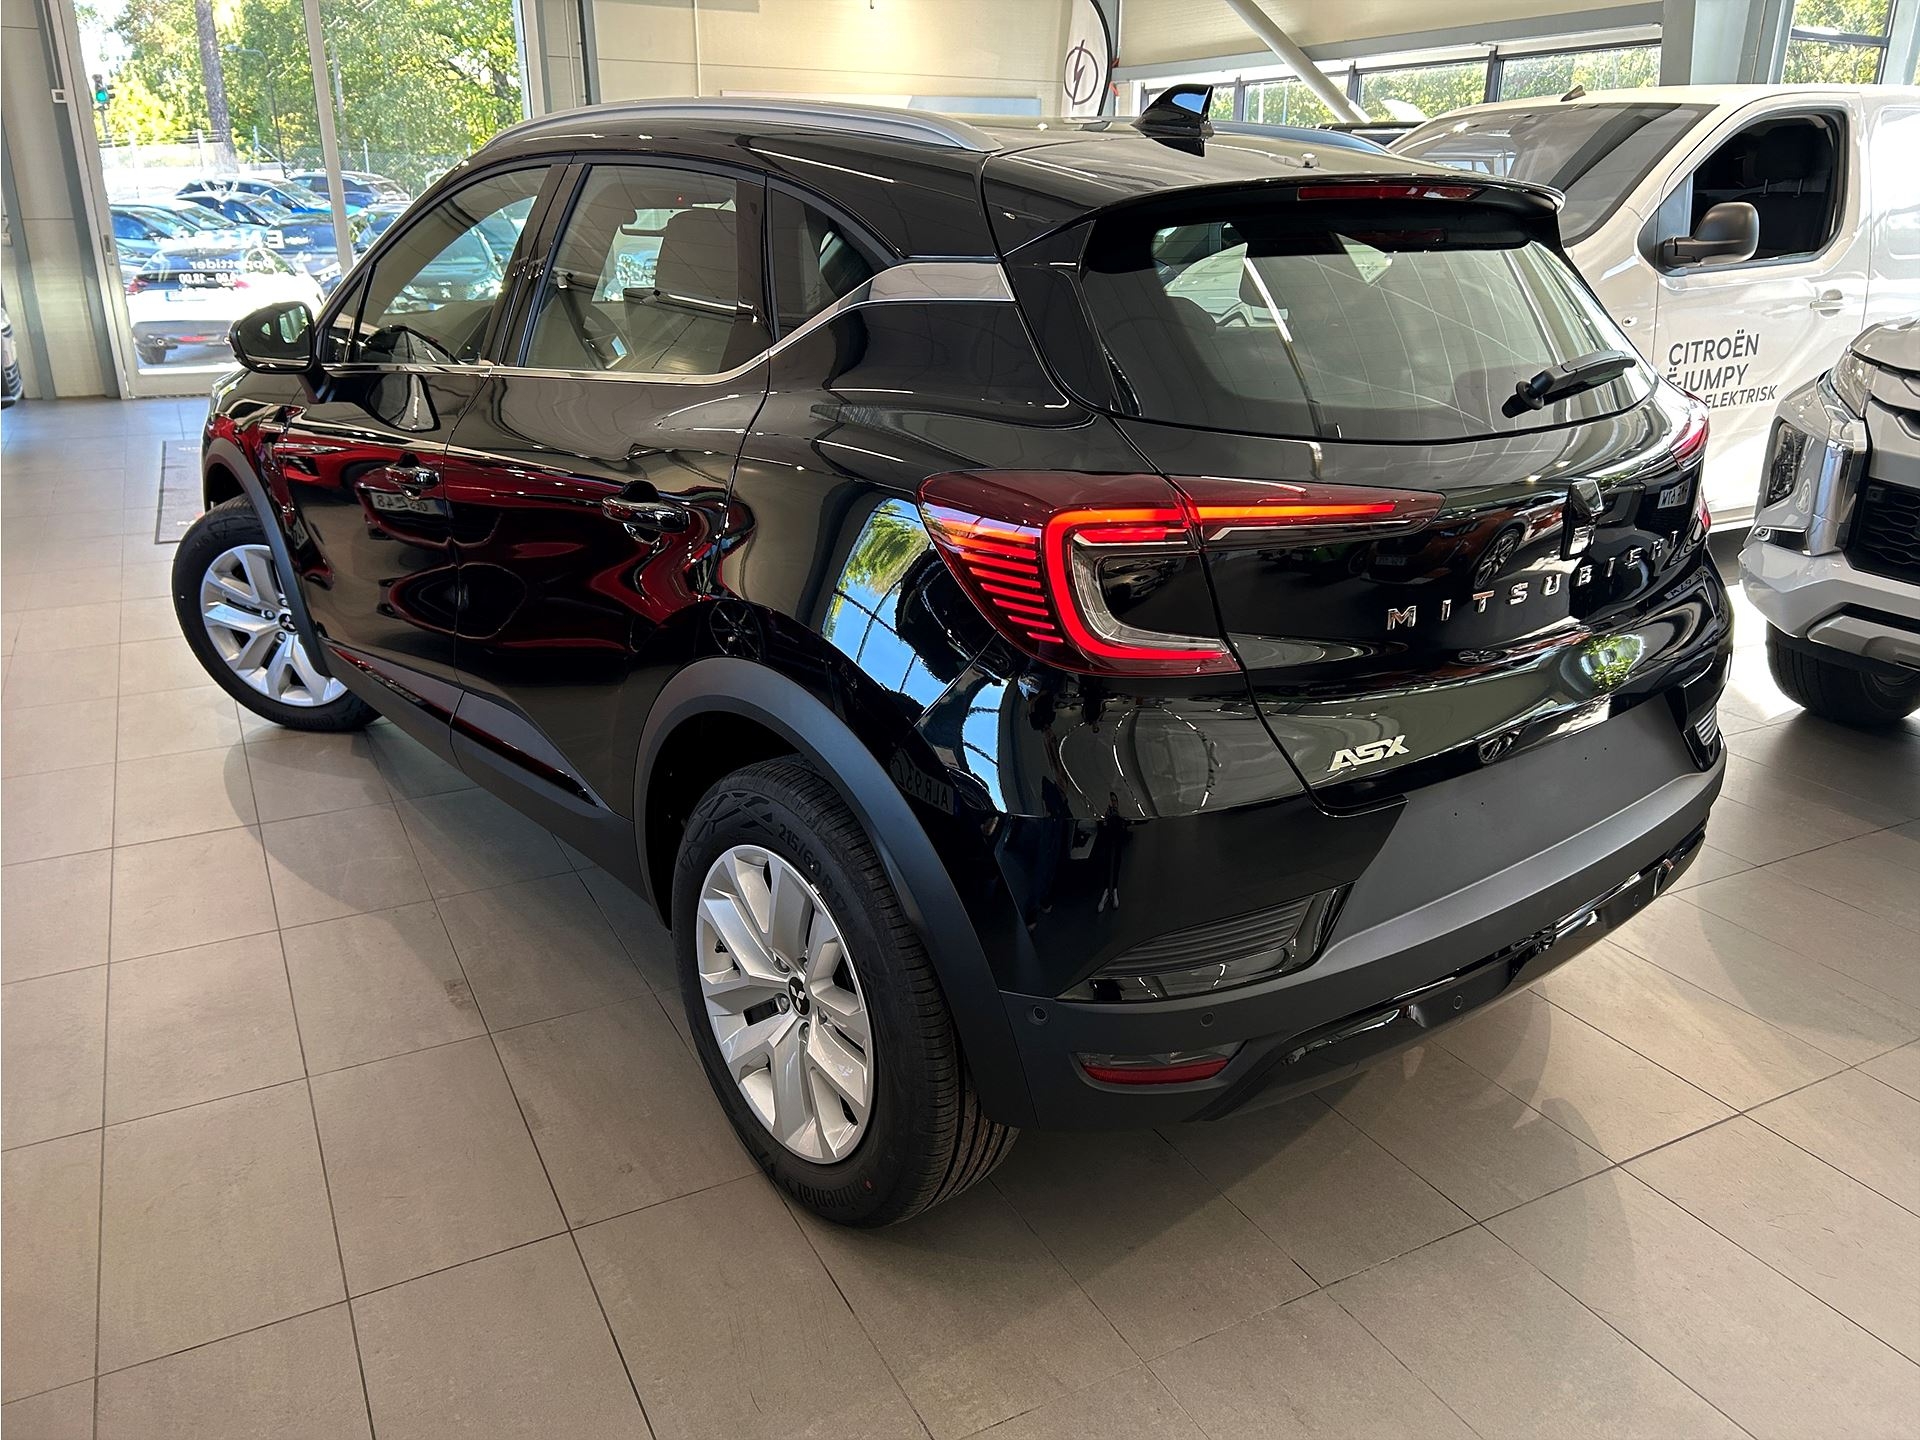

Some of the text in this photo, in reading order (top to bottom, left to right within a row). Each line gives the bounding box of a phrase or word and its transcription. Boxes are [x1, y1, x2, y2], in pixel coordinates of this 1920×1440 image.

[1668, 329, 1759, 365] CITROËN
[1704, 384, 1778, 409] ELEKTRISK
[1386, 530, 1679, 631] MITSUBISHI
[1326, 734, 1410, 773] ASX
